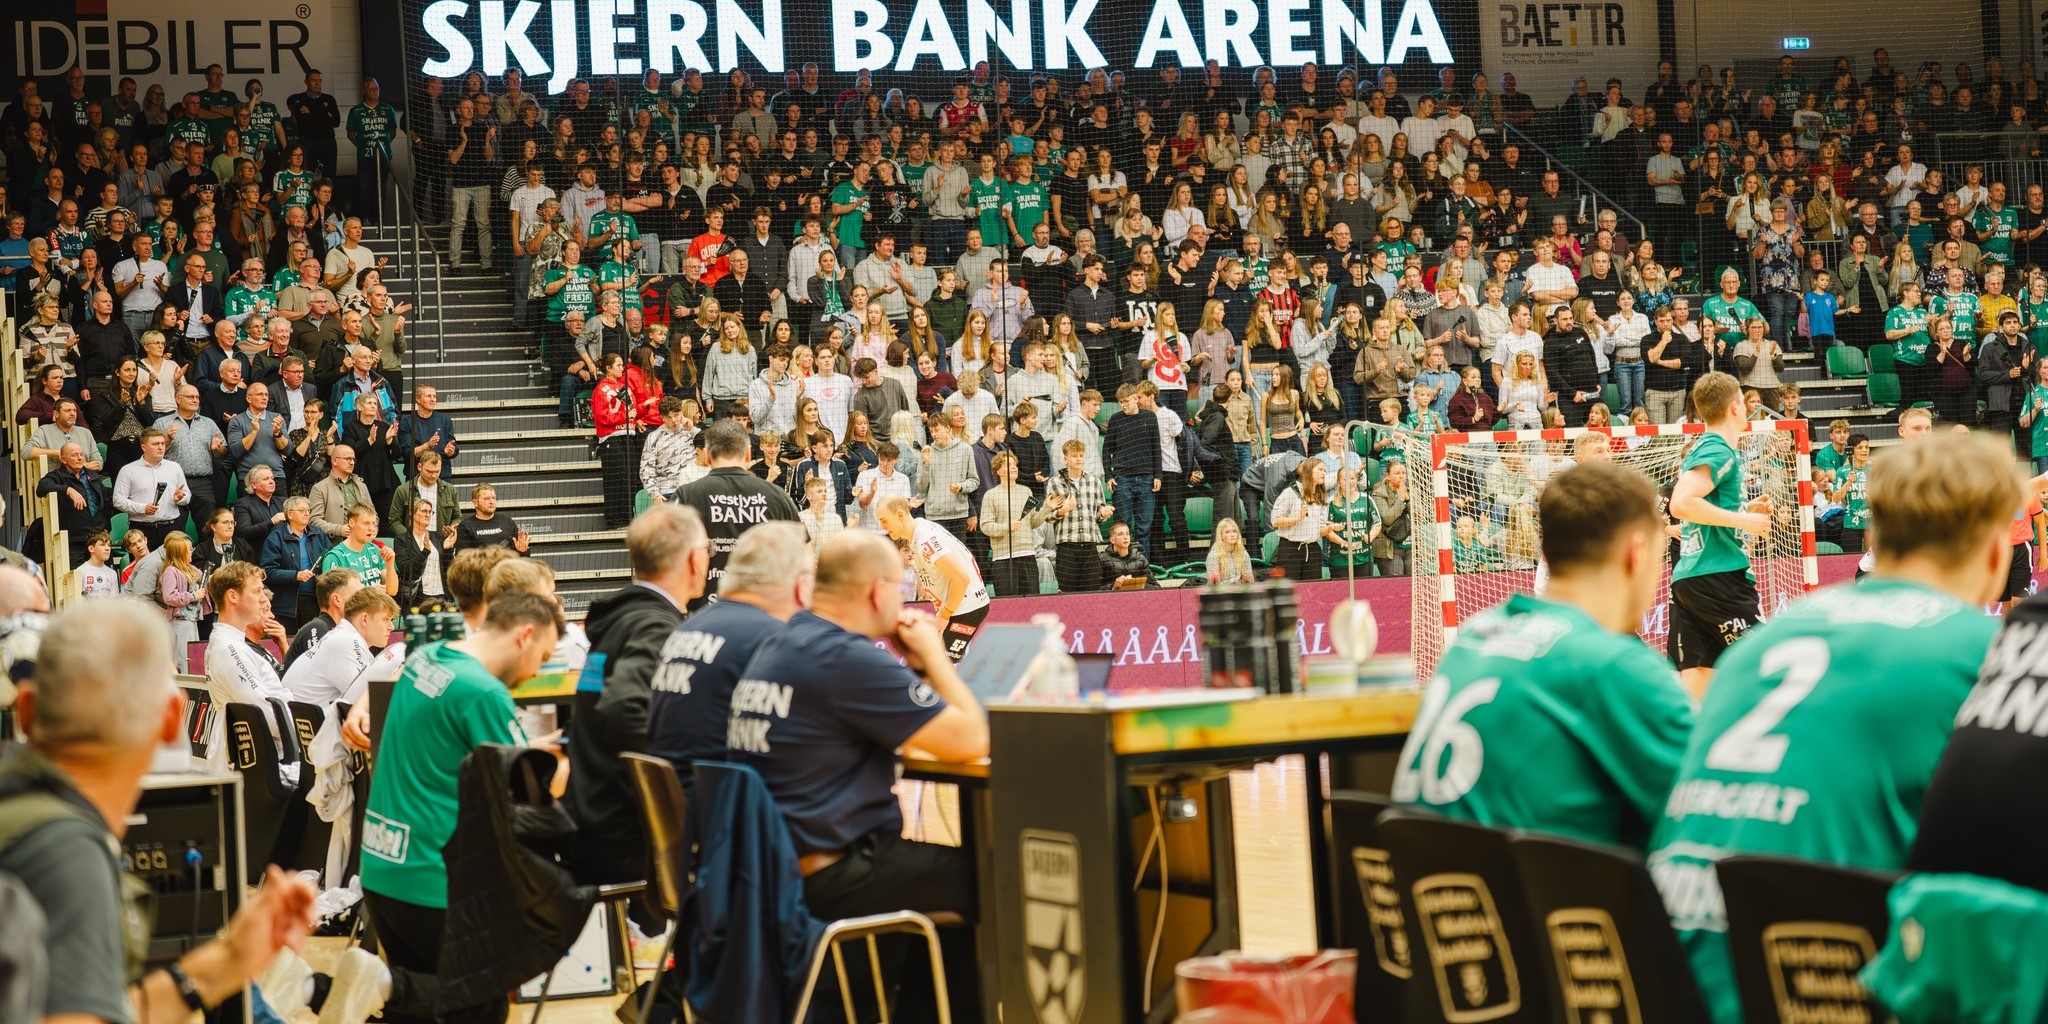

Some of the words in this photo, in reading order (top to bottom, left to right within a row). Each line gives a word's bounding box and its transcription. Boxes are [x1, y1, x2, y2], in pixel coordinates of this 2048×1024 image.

[422, 0, 785, 94] SKJERN
[832, 0, 1109, 71] BANK
[1135, 0, 1455, 67] ARENA
[1502, 51, 1542, 59] Engineering
[565, 284, 590, 292] BANK
[1953, 309, 1970, 317] ANK
[708, 493, 768, 508] vestjysk
[710, 505, 769, 524] BANK
[1705, 636, 1831, 774] 2
